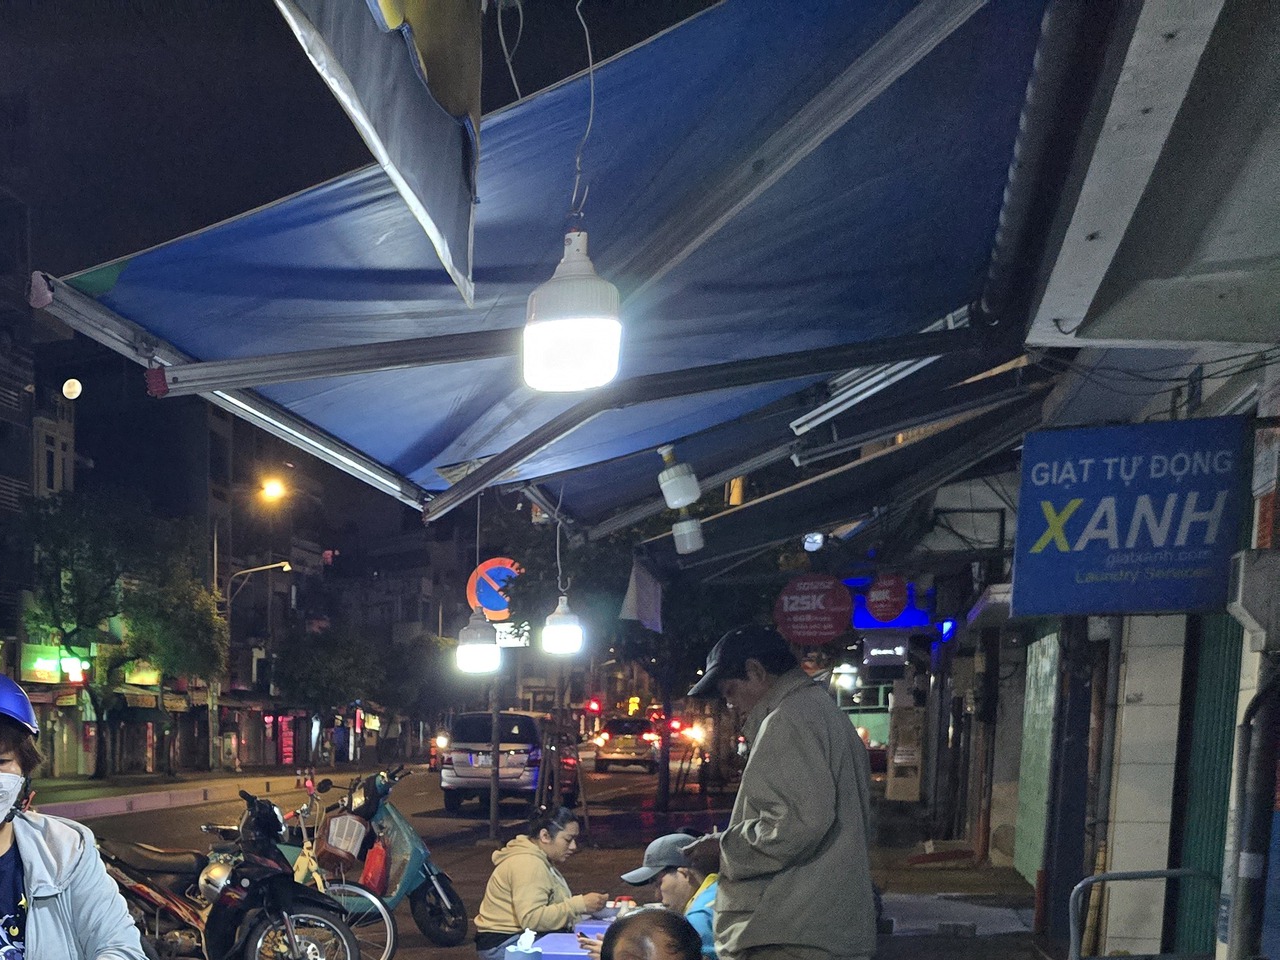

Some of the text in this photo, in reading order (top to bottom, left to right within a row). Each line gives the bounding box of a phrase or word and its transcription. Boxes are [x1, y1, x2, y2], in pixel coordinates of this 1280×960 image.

[1103, 456, 1143, 486] TỰ
[1028, 490, 1229, 553] XANH
[783, 594, 825, 612] 125K
